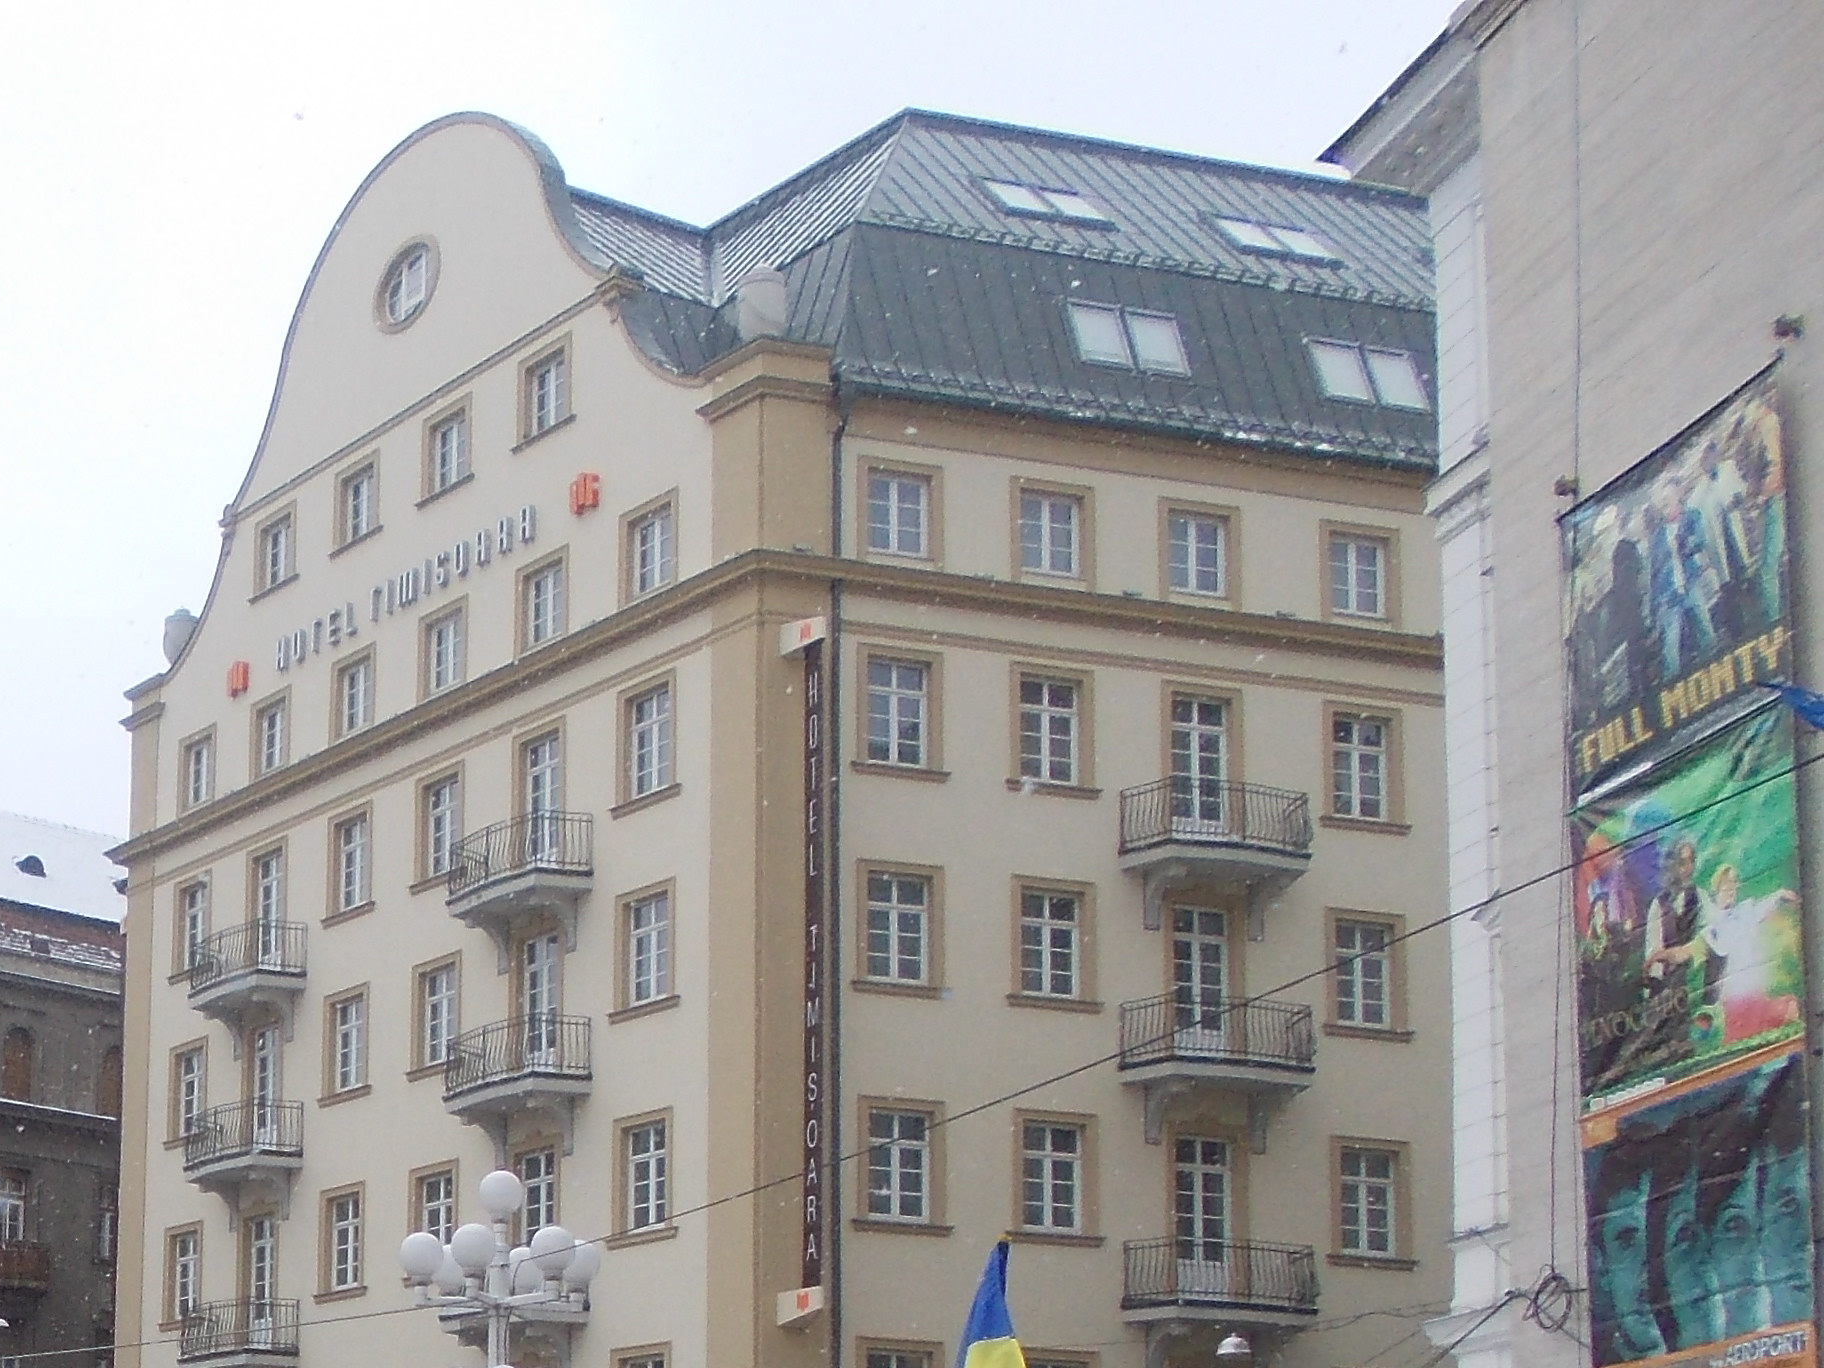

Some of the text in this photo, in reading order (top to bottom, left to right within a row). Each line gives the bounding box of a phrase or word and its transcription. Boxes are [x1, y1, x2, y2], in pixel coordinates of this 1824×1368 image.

[276, 602, 358, 673] HOTEL
[1582, 705, 1655, 773] FULL
[1660, 626, 1785, 729] MONTY
[808, 671, 819, 877] HOTEL
